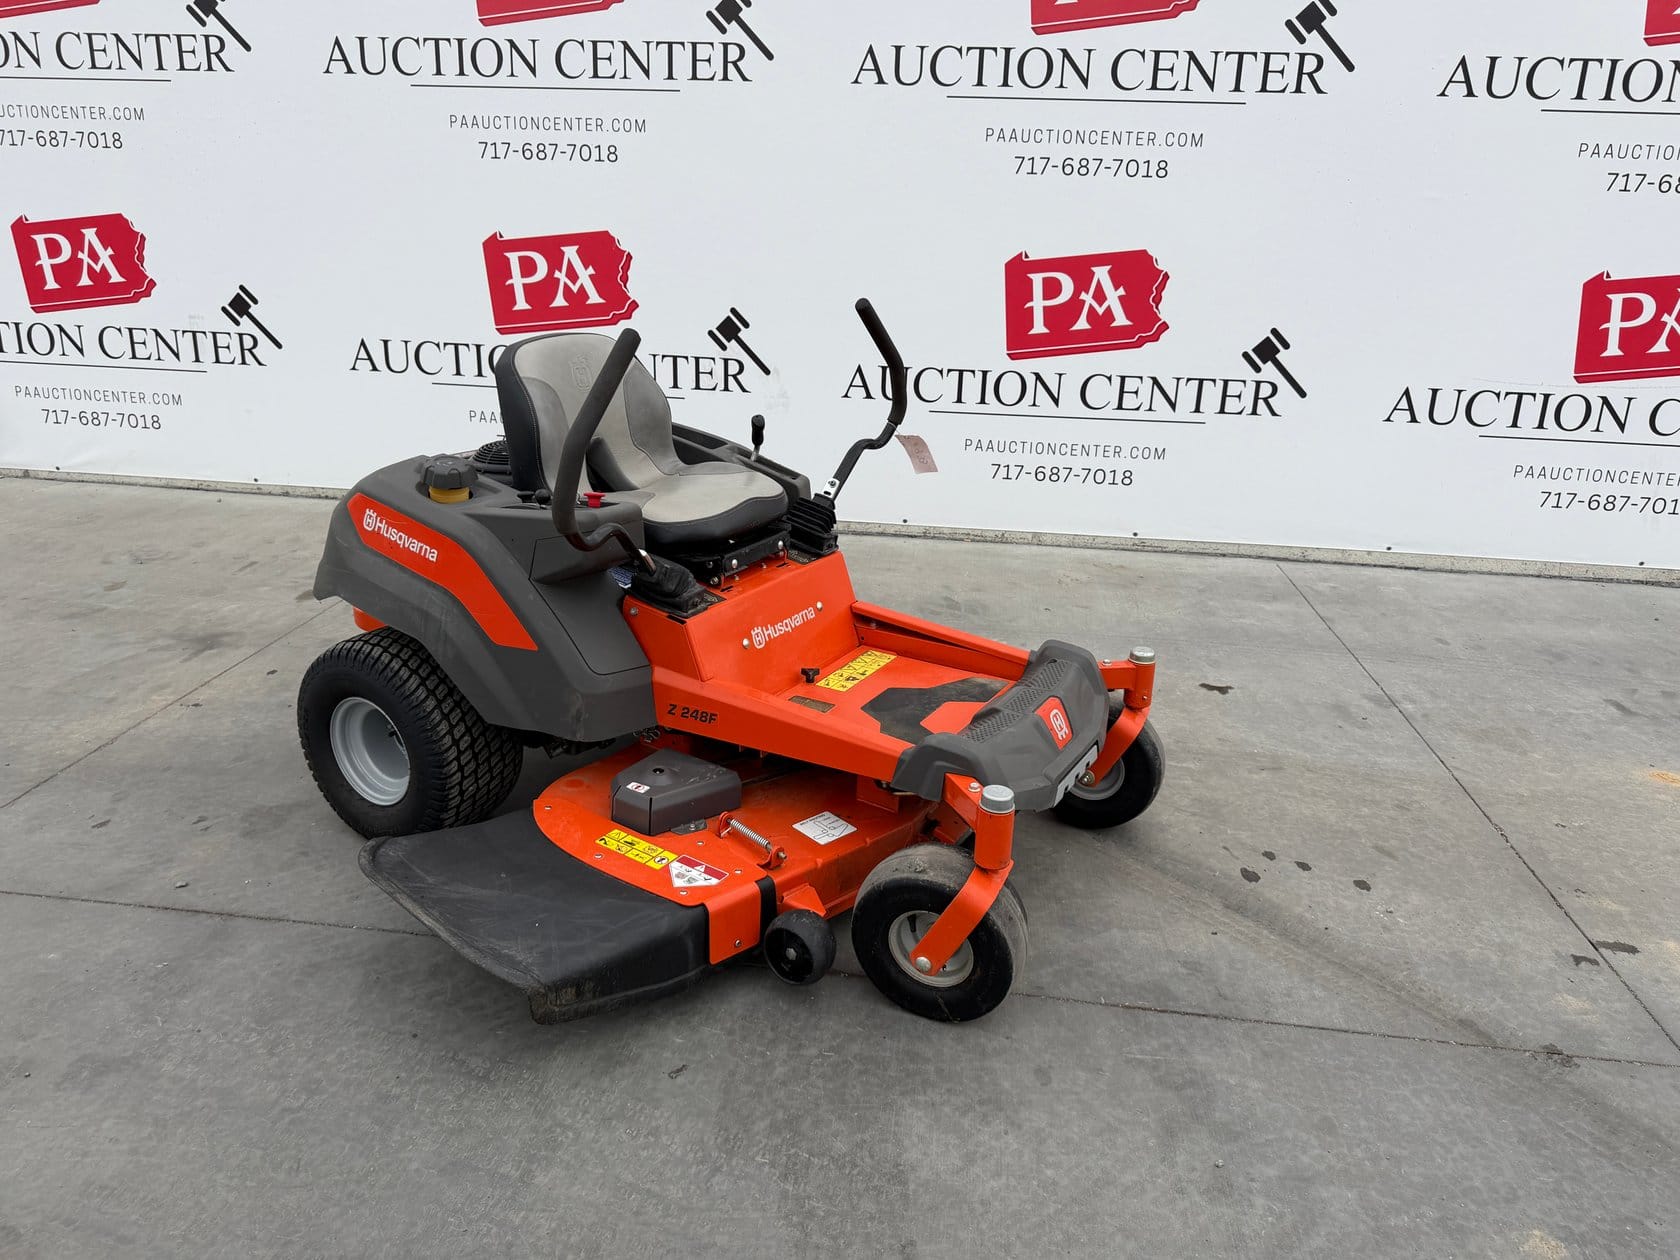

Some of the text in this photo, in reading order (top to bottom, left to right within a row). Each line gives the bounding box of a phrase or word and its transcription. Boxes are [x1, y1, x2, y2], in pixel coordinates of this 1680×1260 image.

[55, 31, 236, 73] CENTER
[323, 35, 753, 83] AUCTION CENTER
[851, 43, 1328, 95] AUCTION CENTER
[449, 114, 647, 134] PAAUCTIONCENTER.COM
[985, 127, 1205, 148] PAAUCTIONCENTER.COM
[478, 141, 618, 163] 717-687-7018
[1578, 142, 1680, 161] PAAUCTIO
[1014, 156, 1169, 179] 717-687-7018
[30, 227, 128, 291] PA
[504, 245, 606, 311] PA
[1024, 264, 1134, 335] PA
[98, 325, 267, 367] CENTER
[14, 385, 183, 406] PAAUCTIONCENTER.COM
[841, 364, 1282, 417] AUCTION CENTER
[41, 408, 162, 430] 717-687-7018
[1382, 386, 1638, 435] AUCTION
[964, 438, 1167, 461] PAAUCTIONCENTER.COM
[990, 463, 1133, 487] 717-687-7018
[1513, 464, 1680, 487] PAAUCTIONCENTE
[375, 516, 439, 563] Husqvarna
[763, 606, 816, 642] Husqvarna
[667, 703, 718, 725] Z 248F
